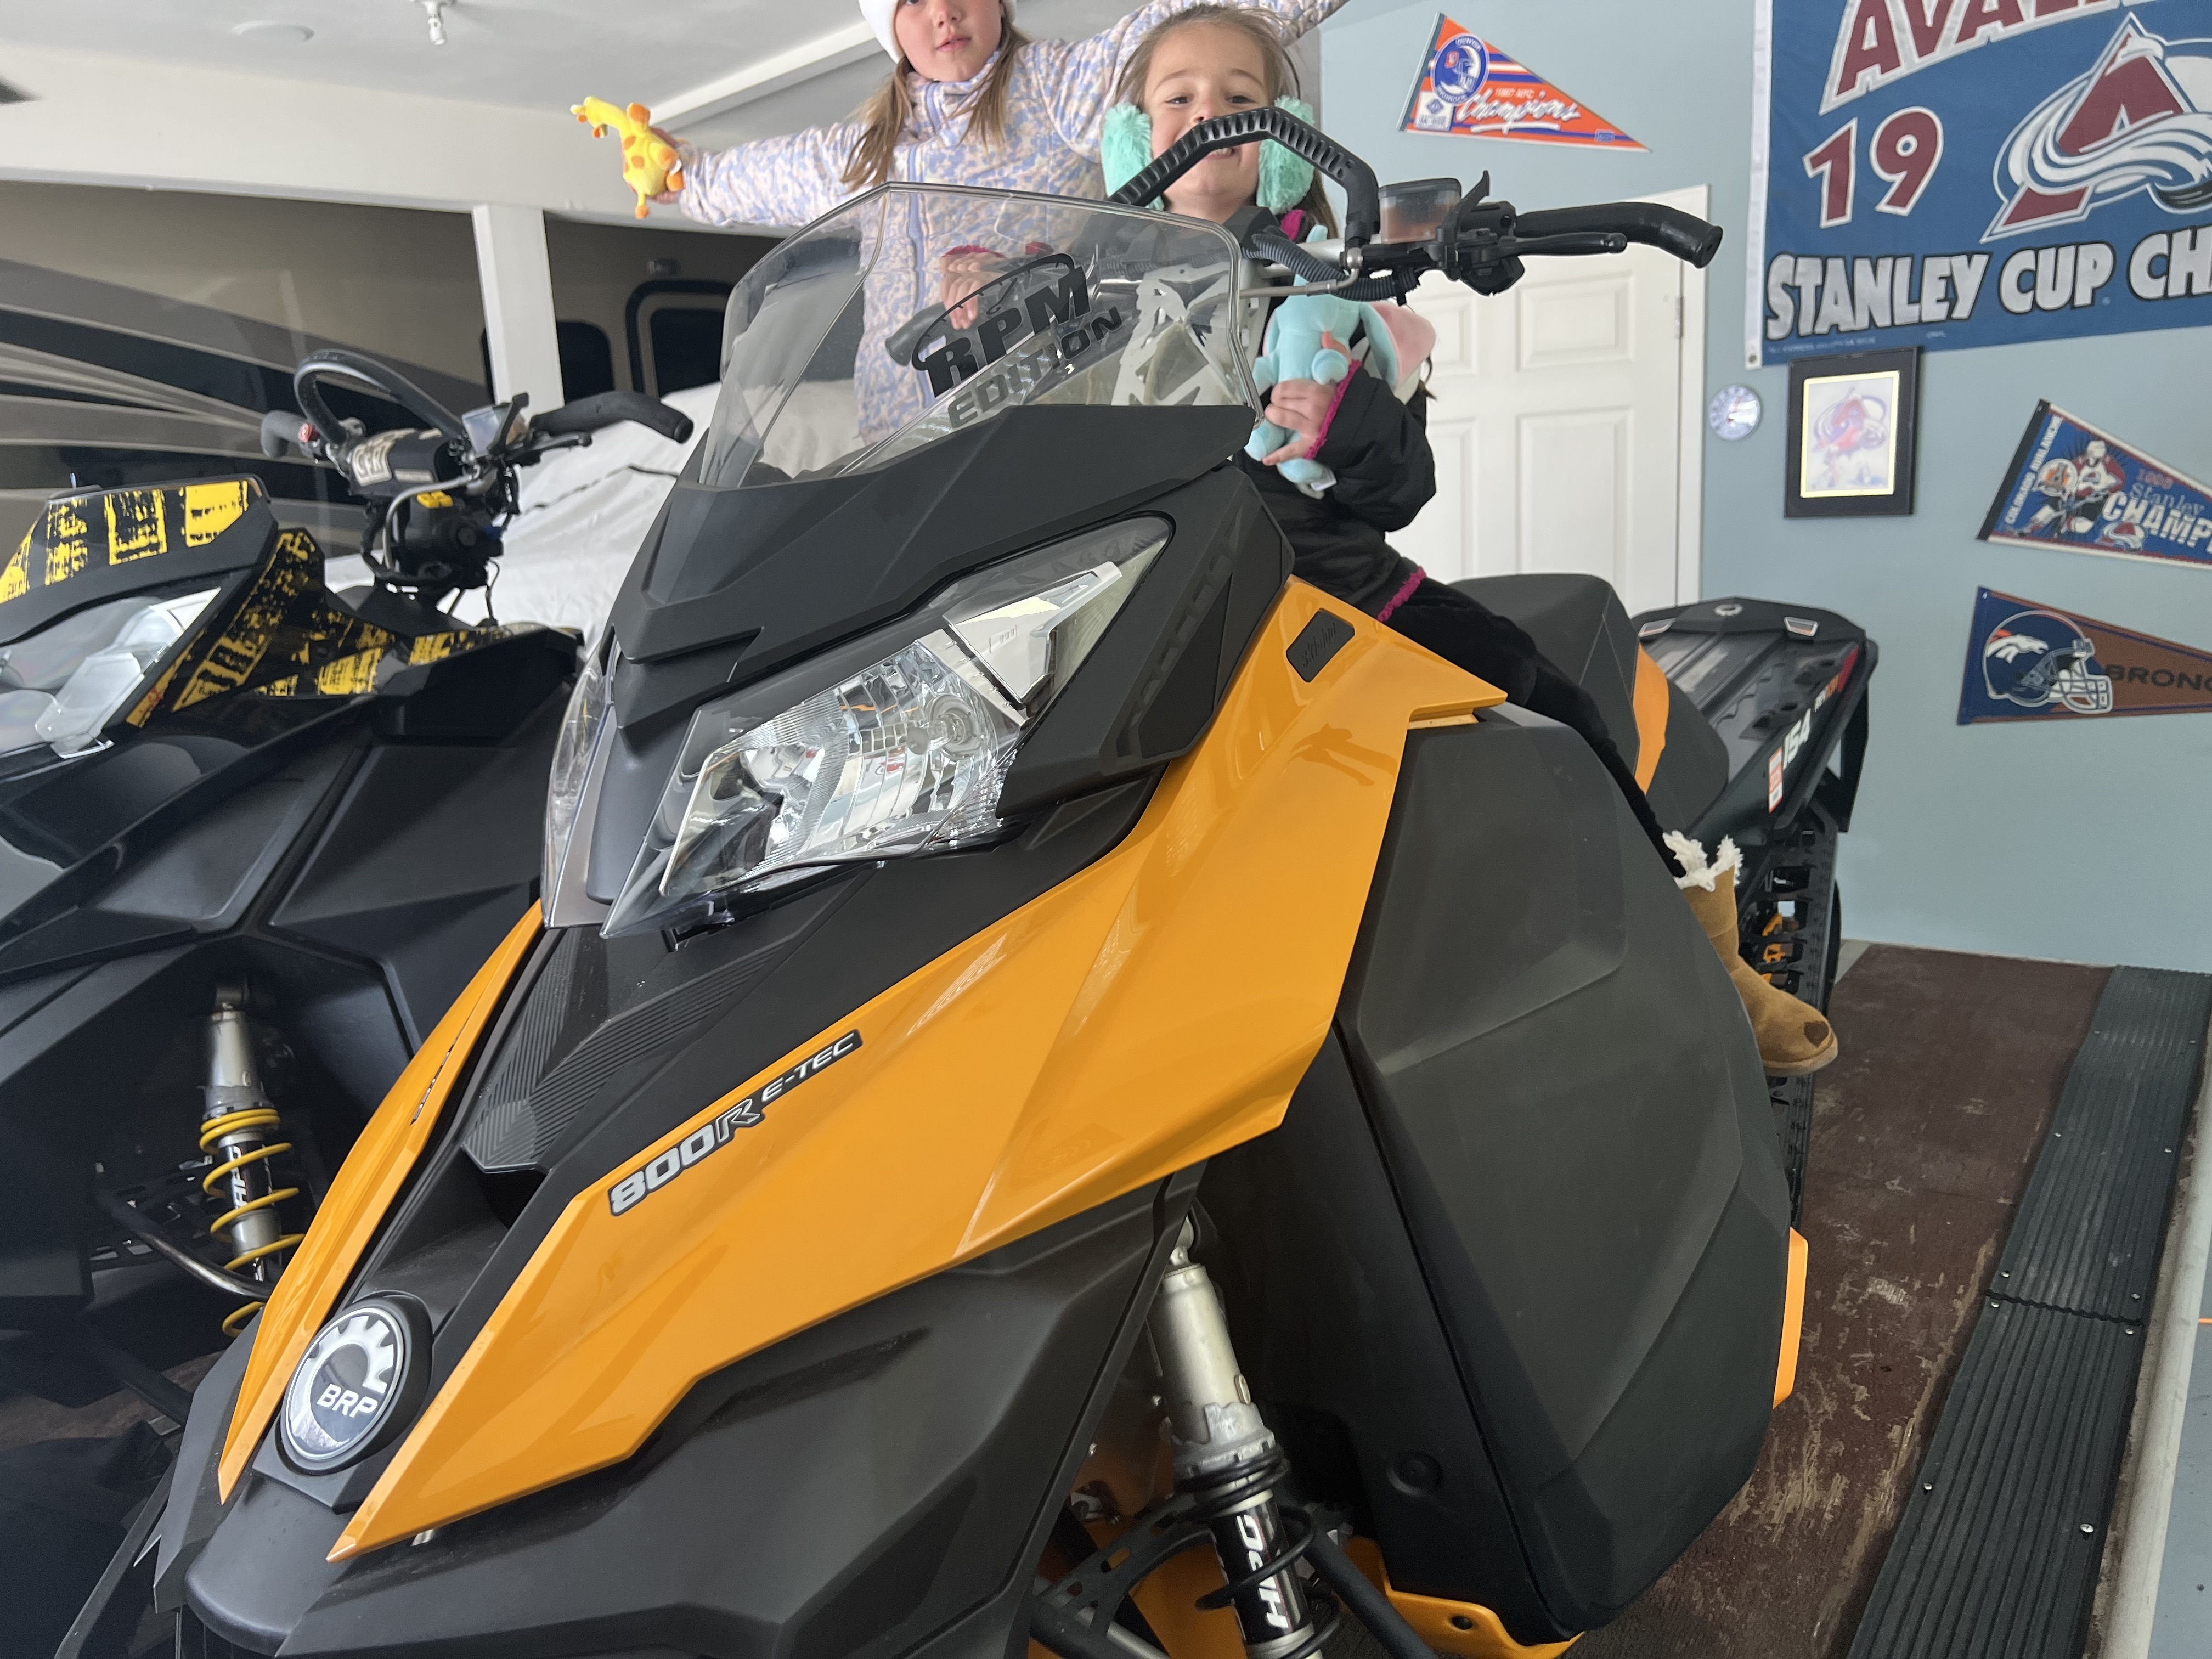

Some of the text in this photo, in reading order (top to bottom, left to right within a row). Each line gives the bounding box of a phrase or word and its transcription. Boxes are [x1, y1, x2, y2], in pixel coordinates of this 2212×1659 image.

[1455, 88, 1581, 136] Champions
[1803, 106, 1944, 229] 19
[924, 266, 1091, 398] RPM
[1767, 223, 2212, 341] STANLEY CUP CH
[947, 306, 1123, 428] EDITION
[2102, 490, 2212, 555] CHAMP
[2129, 482, 2207, 517] Stanley
[609, 1032, 855, 1216] 800R E-TEC
[316, 1383, 379, 1418] BRP
